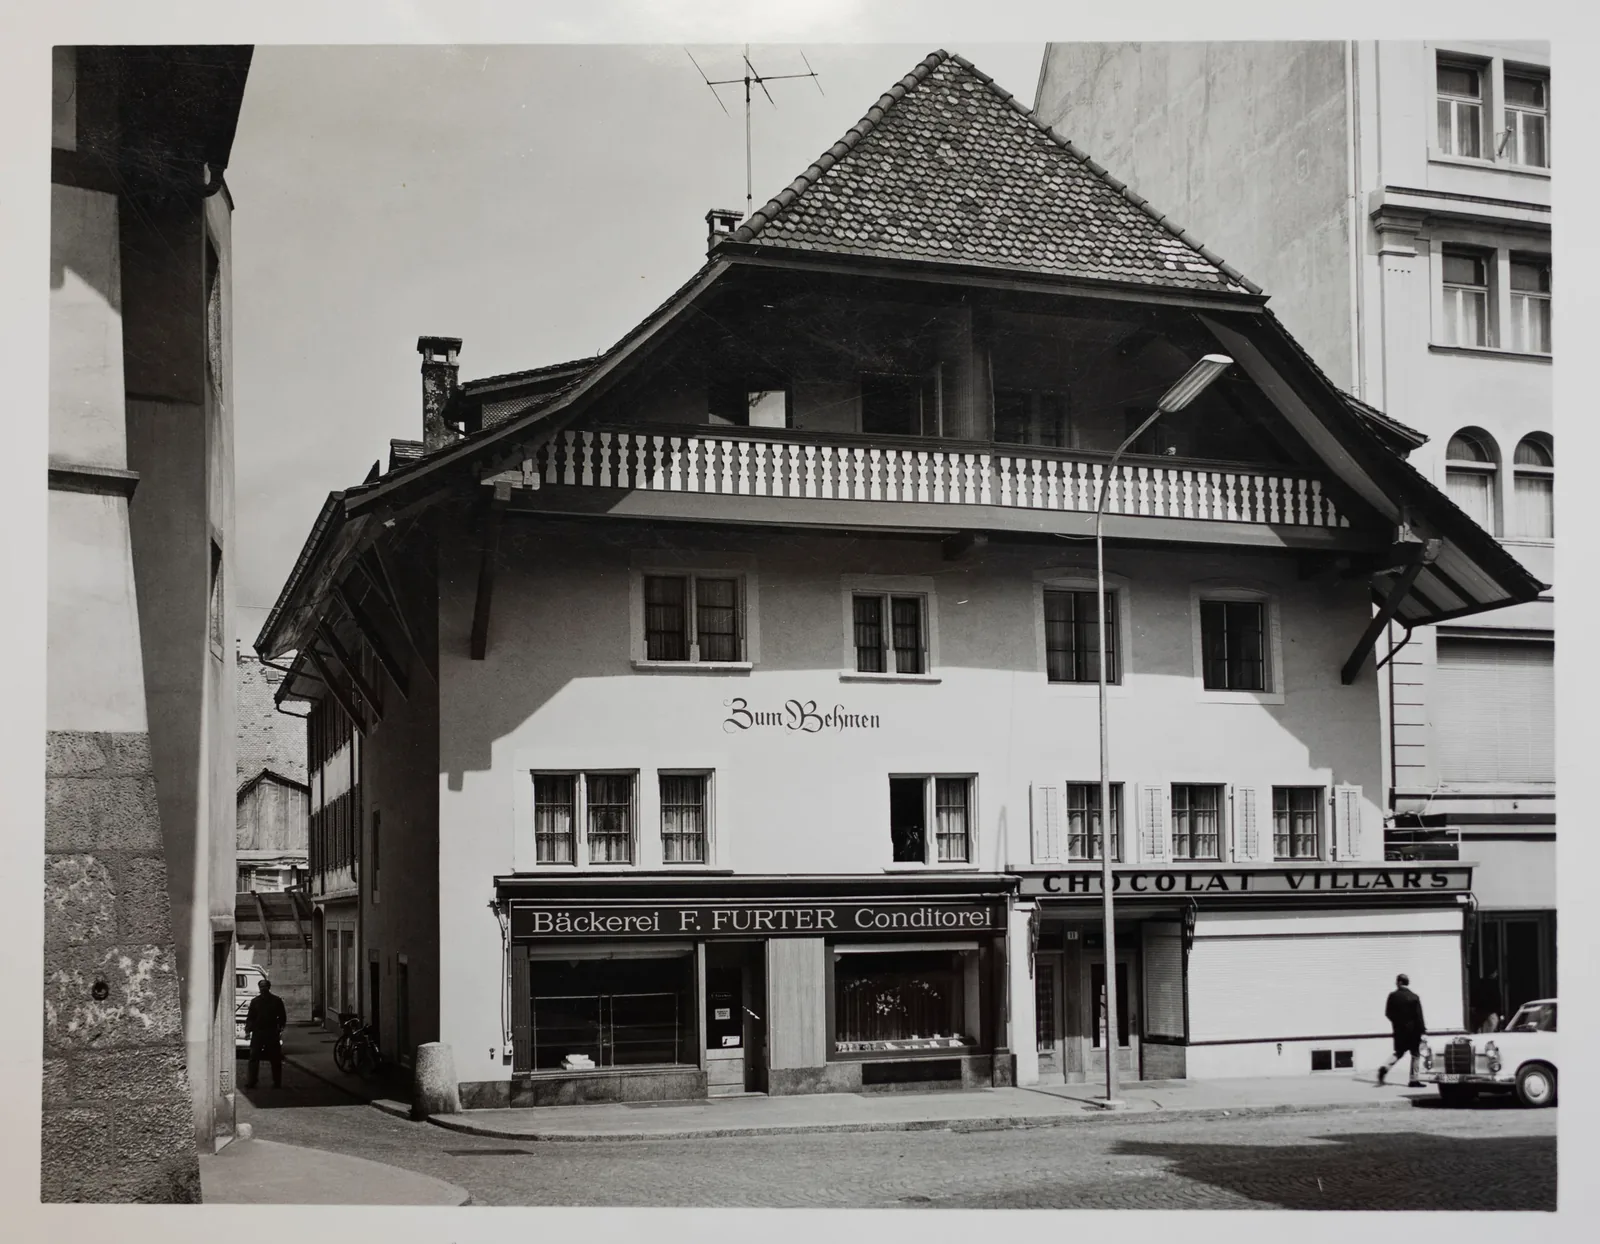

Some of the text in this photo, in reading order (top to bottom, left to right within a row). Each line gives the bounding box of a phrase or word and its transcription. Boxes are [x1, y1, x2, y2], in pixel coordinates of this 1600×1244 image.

[723, 697, 880, 735] Zum Behmen
[1042, 870, 1449, 893] CHOCOLAT VILLARS
[532, 907, 992, 933] Bäckerei F. FURTER Conditorei
